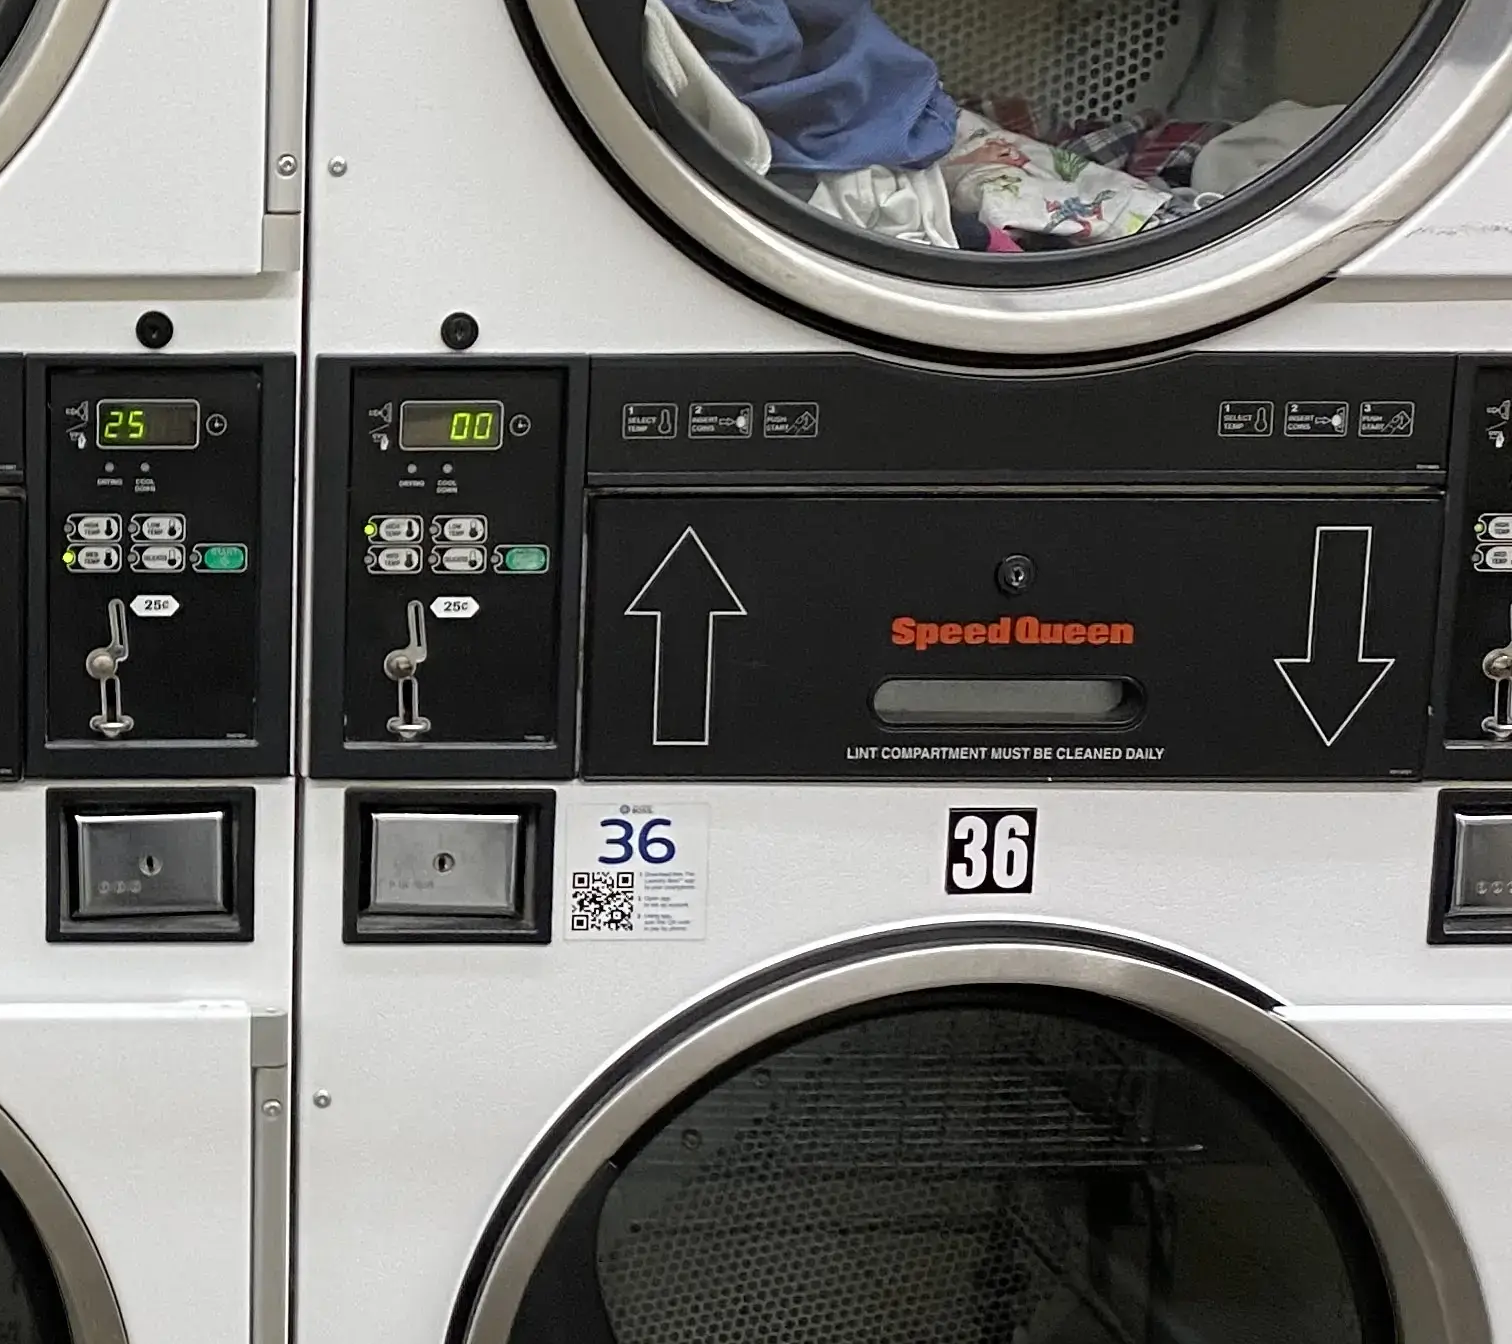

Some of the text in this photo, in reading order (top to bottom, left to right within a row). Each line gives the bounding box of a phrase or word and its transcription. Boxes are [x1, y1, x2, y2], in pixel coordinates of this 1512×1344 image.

[104, 410, 145, 438] 25
[450, 412, 493, 440] 00
[892, 615, 1135, 650] Speed Queen
[846, 747, 1165, 760] LINT COMPARTMENT MUST BE CLEANED DAILY
[598, 818, 676, 864] 36
[951, 813, 1029, 889] 36
